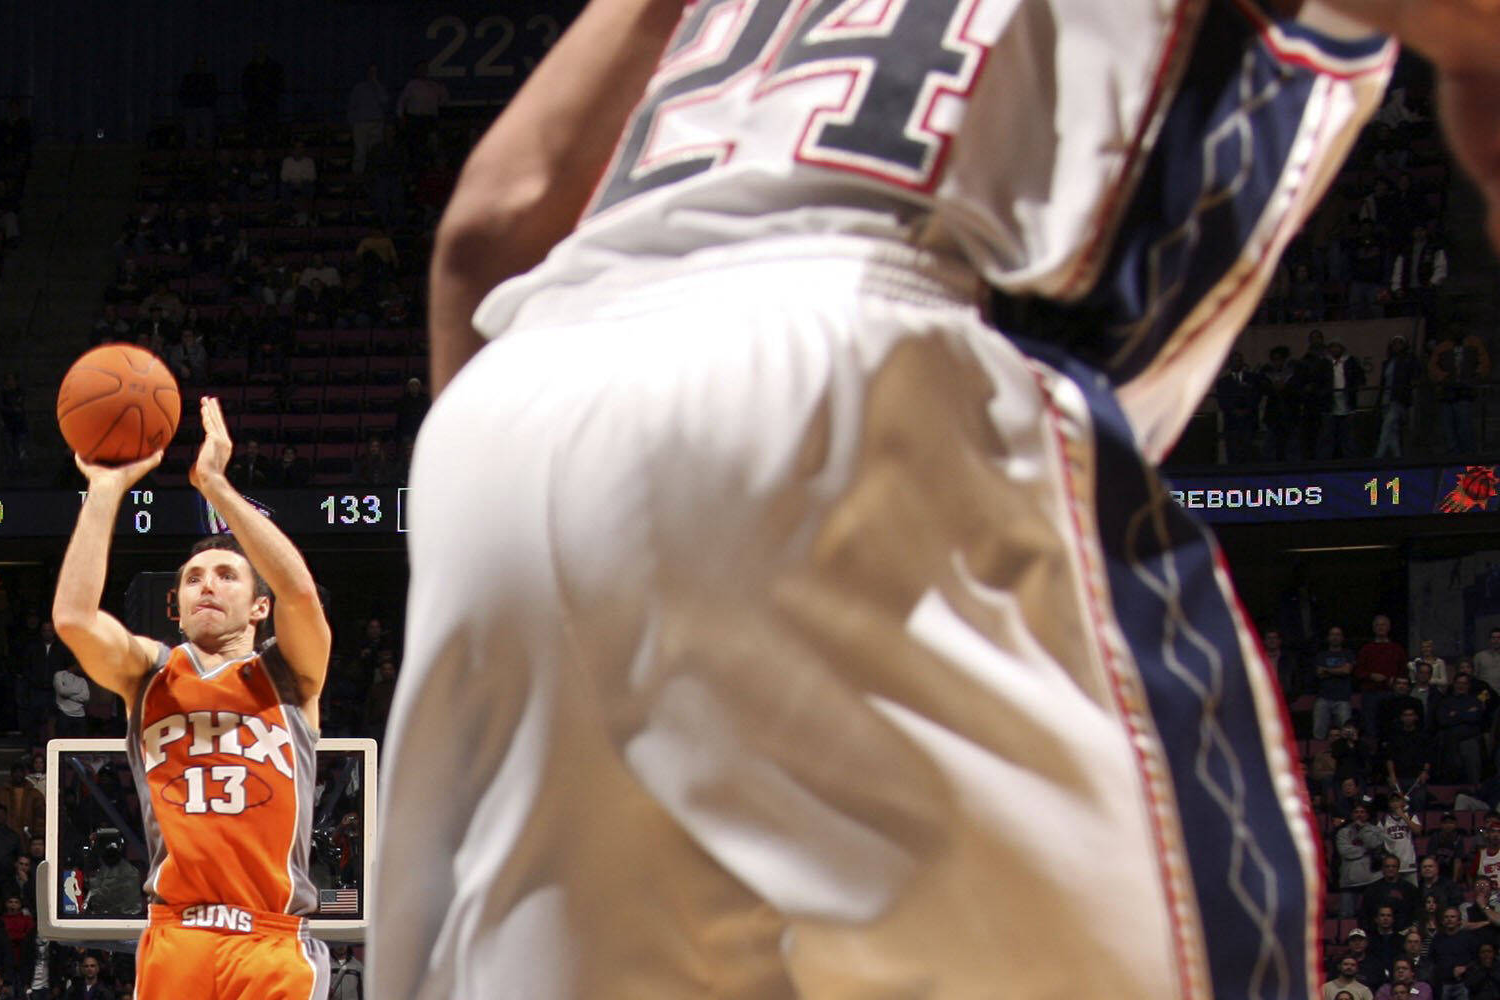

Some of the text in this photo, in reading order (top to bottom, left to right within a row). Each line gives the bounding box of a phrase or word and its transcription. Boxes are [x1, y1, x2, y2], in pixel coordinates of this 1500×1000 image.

[1364, 477, 1400, 505] 11
[321, 495, 382, 524] 133
[143, 710, 294, 783] PHX
[183, 765, 248, 815] 13
[181, 904, 252, 933] SUNS
